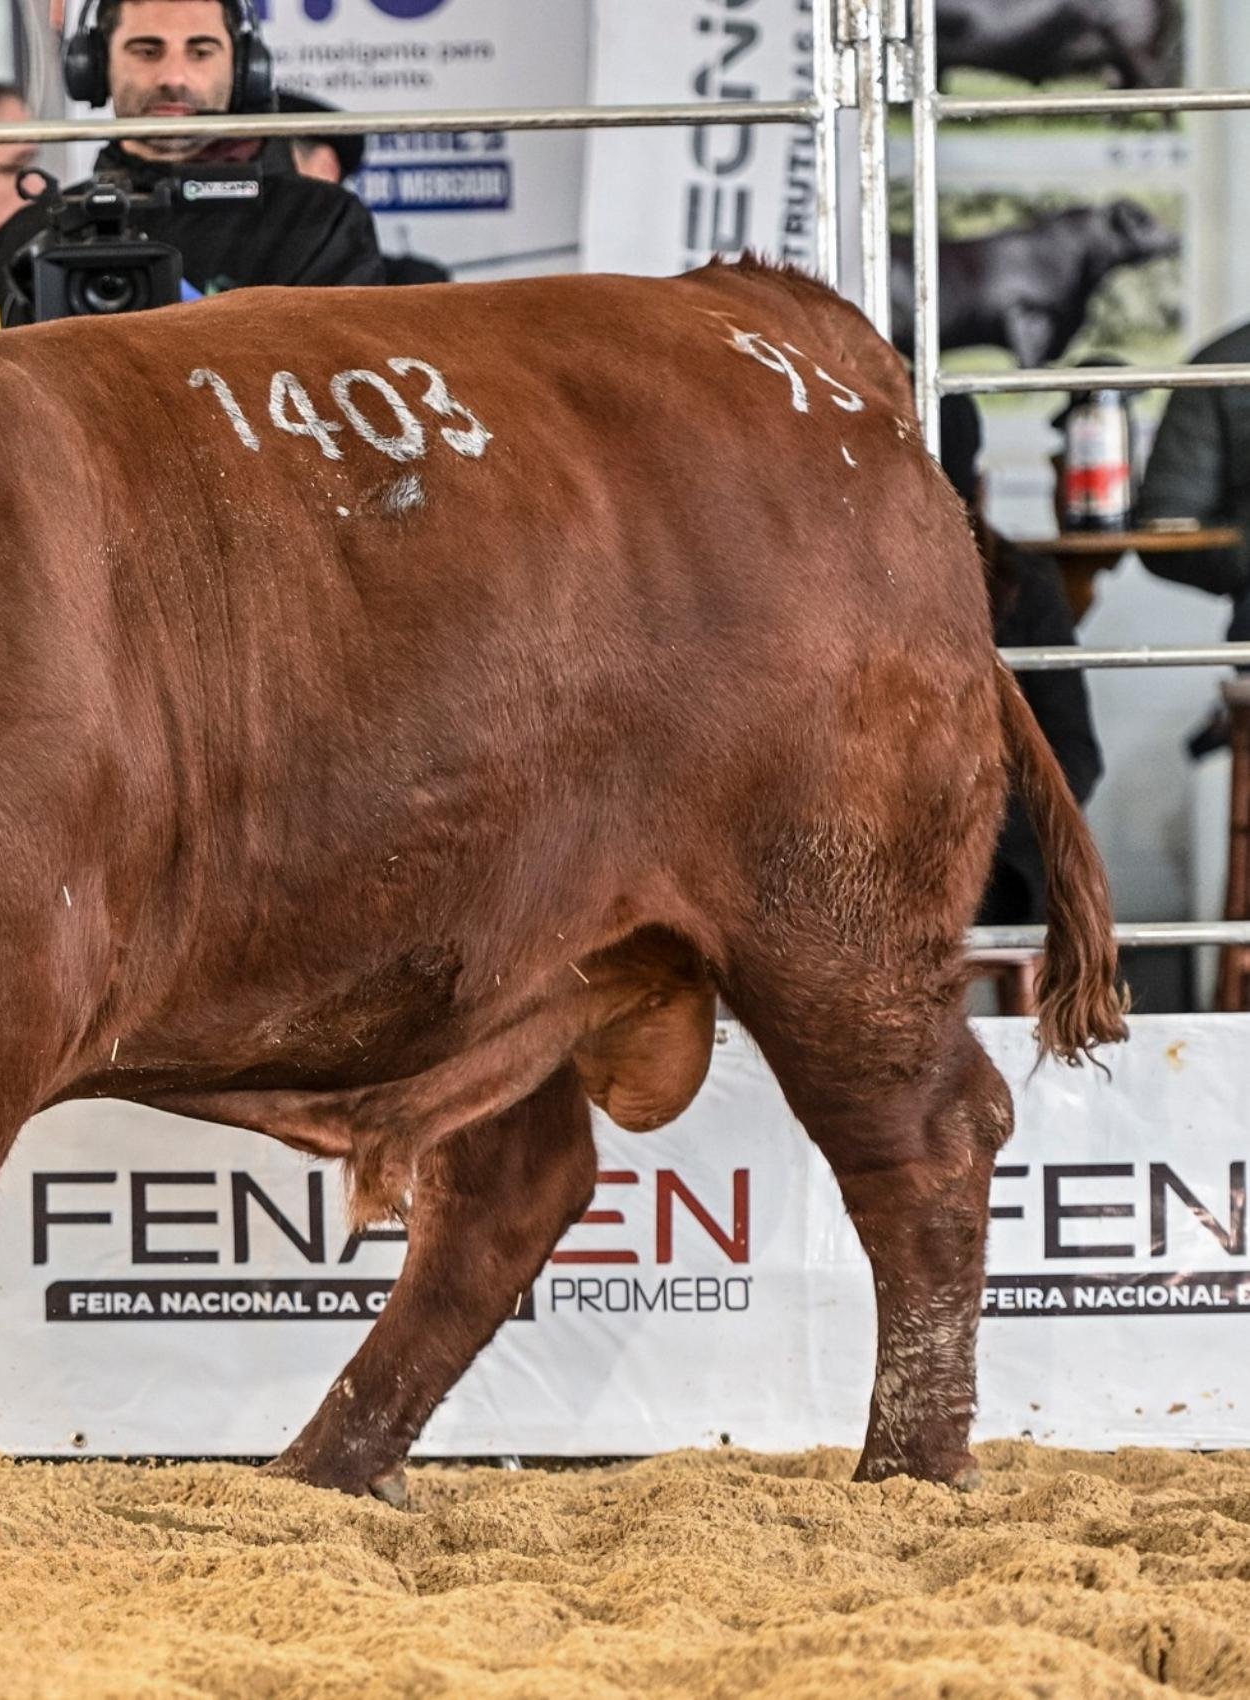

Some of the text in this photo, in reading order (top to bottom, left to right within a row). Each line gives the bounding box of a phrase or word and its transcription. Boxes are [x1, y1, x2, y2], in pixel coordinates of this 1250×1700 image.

[188, 357, 494, 461] 1403
[69, 1292, 154, 1314] FEIRA
[161, 1292, 311, 1314] NACIONAL
[318, 1292, 361, 1314] DA
[981, 1287, 1067, 1310] FEIRA
[1073, 1285, 1230, 1308] NACIONAL
